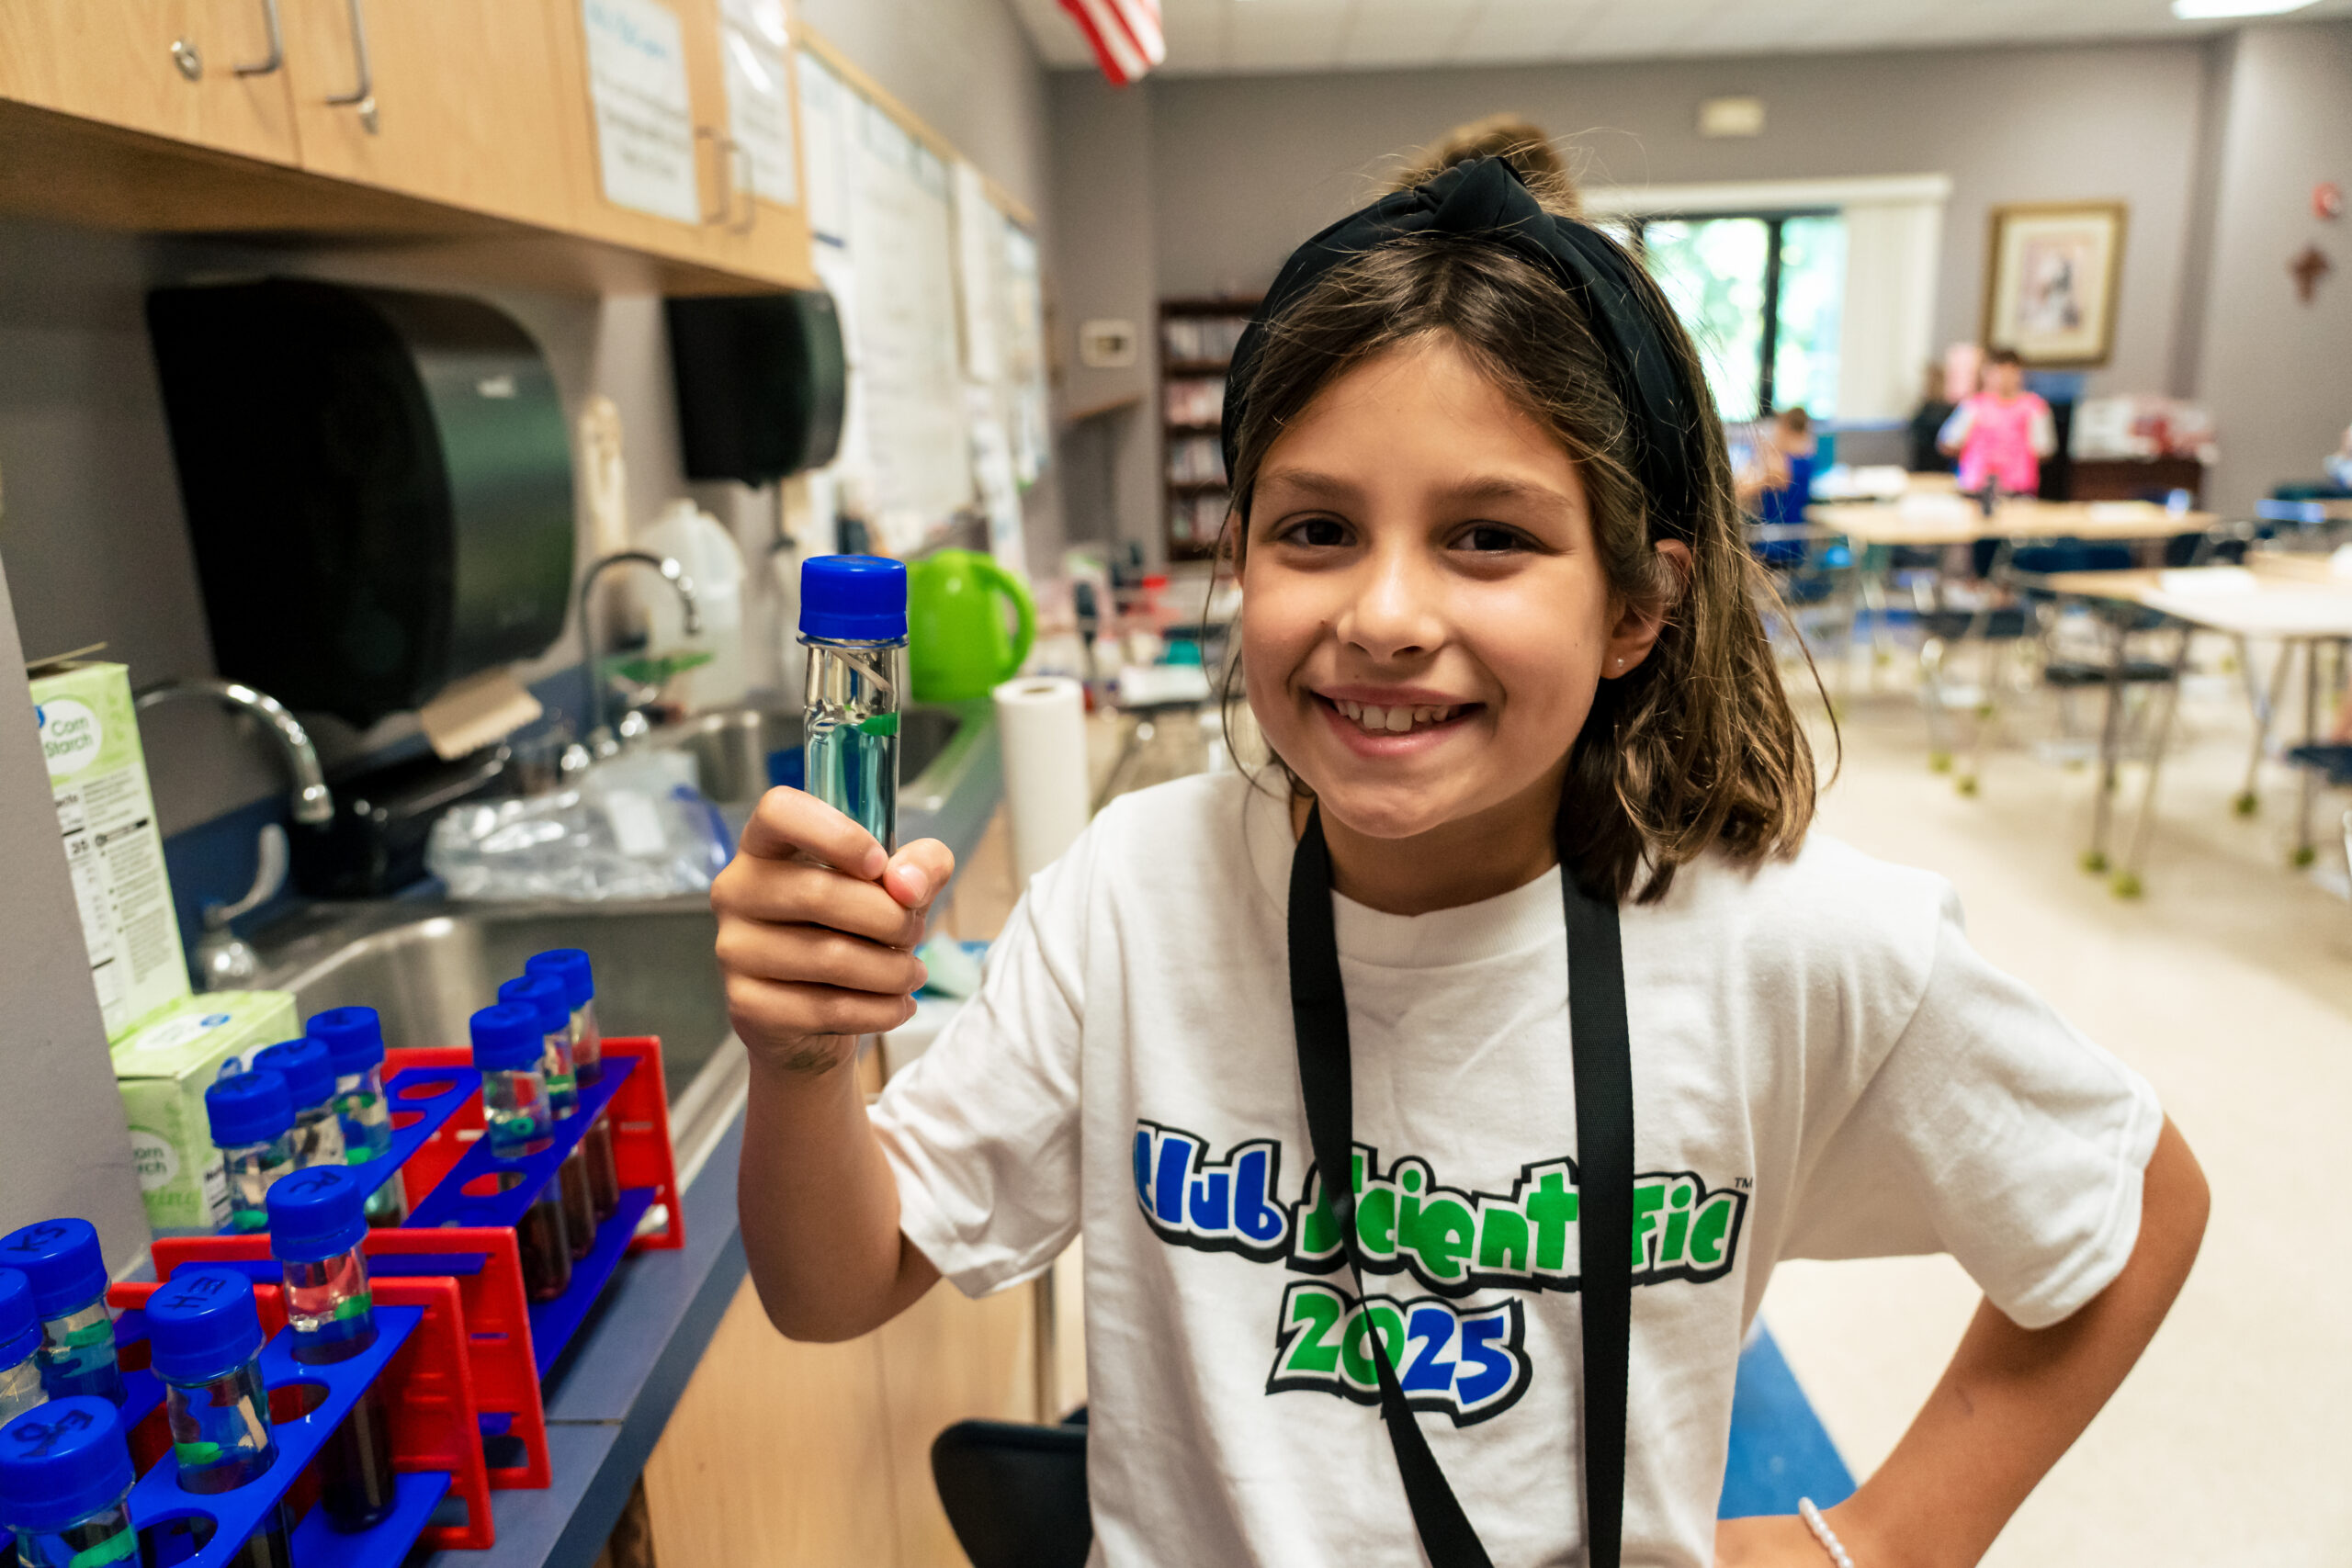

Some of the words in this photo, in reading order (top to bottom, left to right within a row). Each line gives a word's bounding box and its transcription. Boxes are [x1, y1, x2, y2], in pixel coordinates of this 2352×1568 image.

[51, 717, 89, 737] Corn
[44, 735, 94, 758] Starch
[132, 1148, 164, 1159] orn
[1275, 1286, 1522, 1417] 2025
